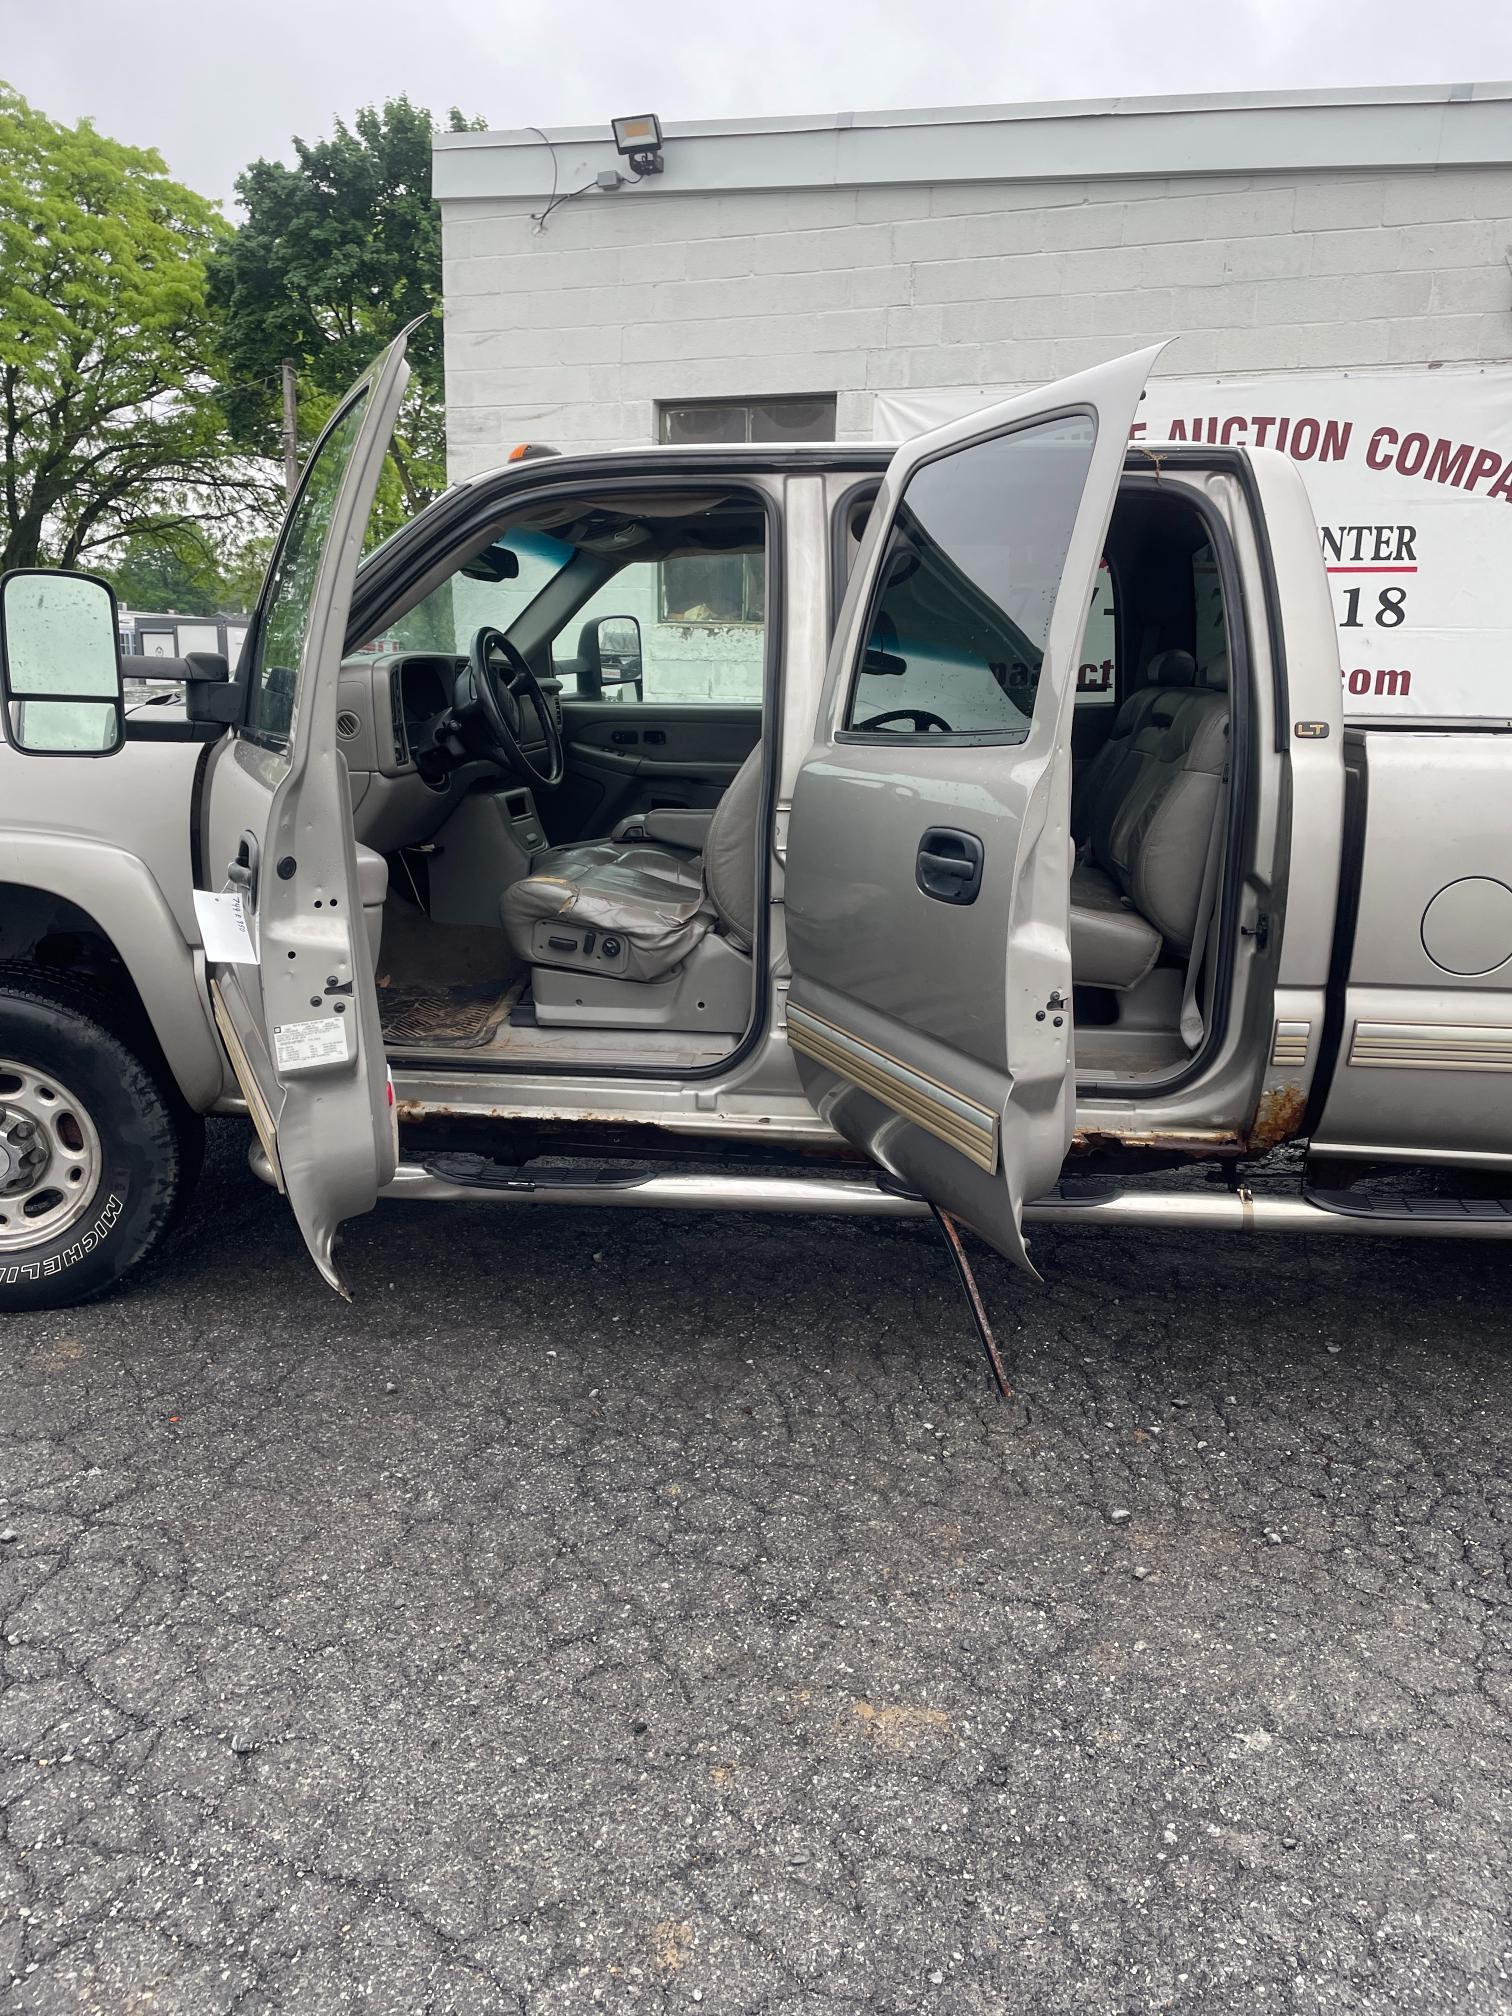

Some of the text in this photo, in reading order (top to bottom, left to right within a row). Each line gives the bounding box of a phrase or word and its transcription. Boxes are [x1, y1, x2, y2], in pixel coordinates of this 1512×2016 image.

[1168, 416, 1353, 462] AUCTION
[1320, 525, 1417, 562] NTER
[1298, 724, 1324, 735] LT
